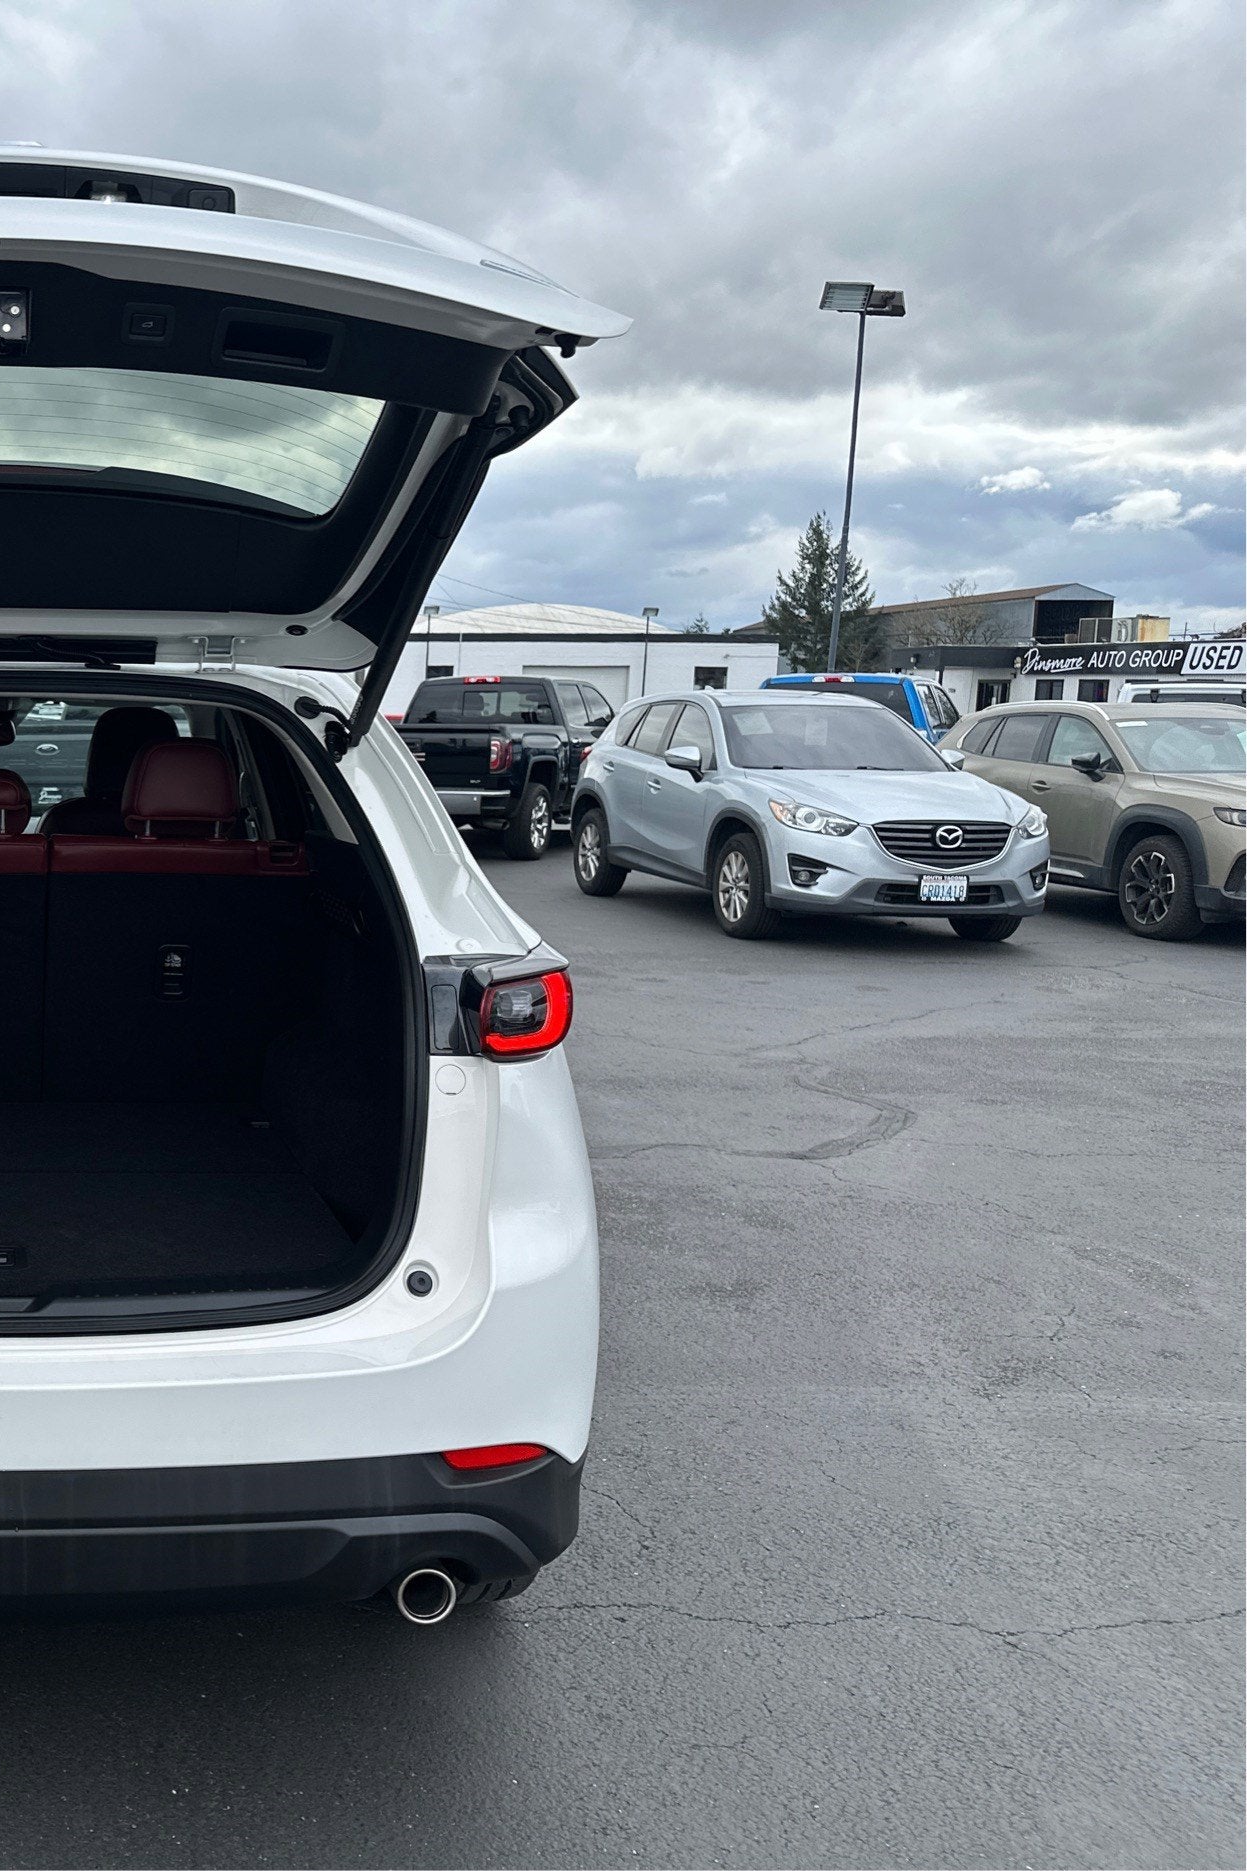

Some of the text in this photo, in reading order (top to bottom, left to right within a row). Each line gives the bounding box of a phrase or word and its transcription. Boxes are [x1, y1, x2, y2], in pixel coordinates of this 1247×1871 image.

[1021, 645, 1244, 675] Dinsmore AUTO GROUP USED
